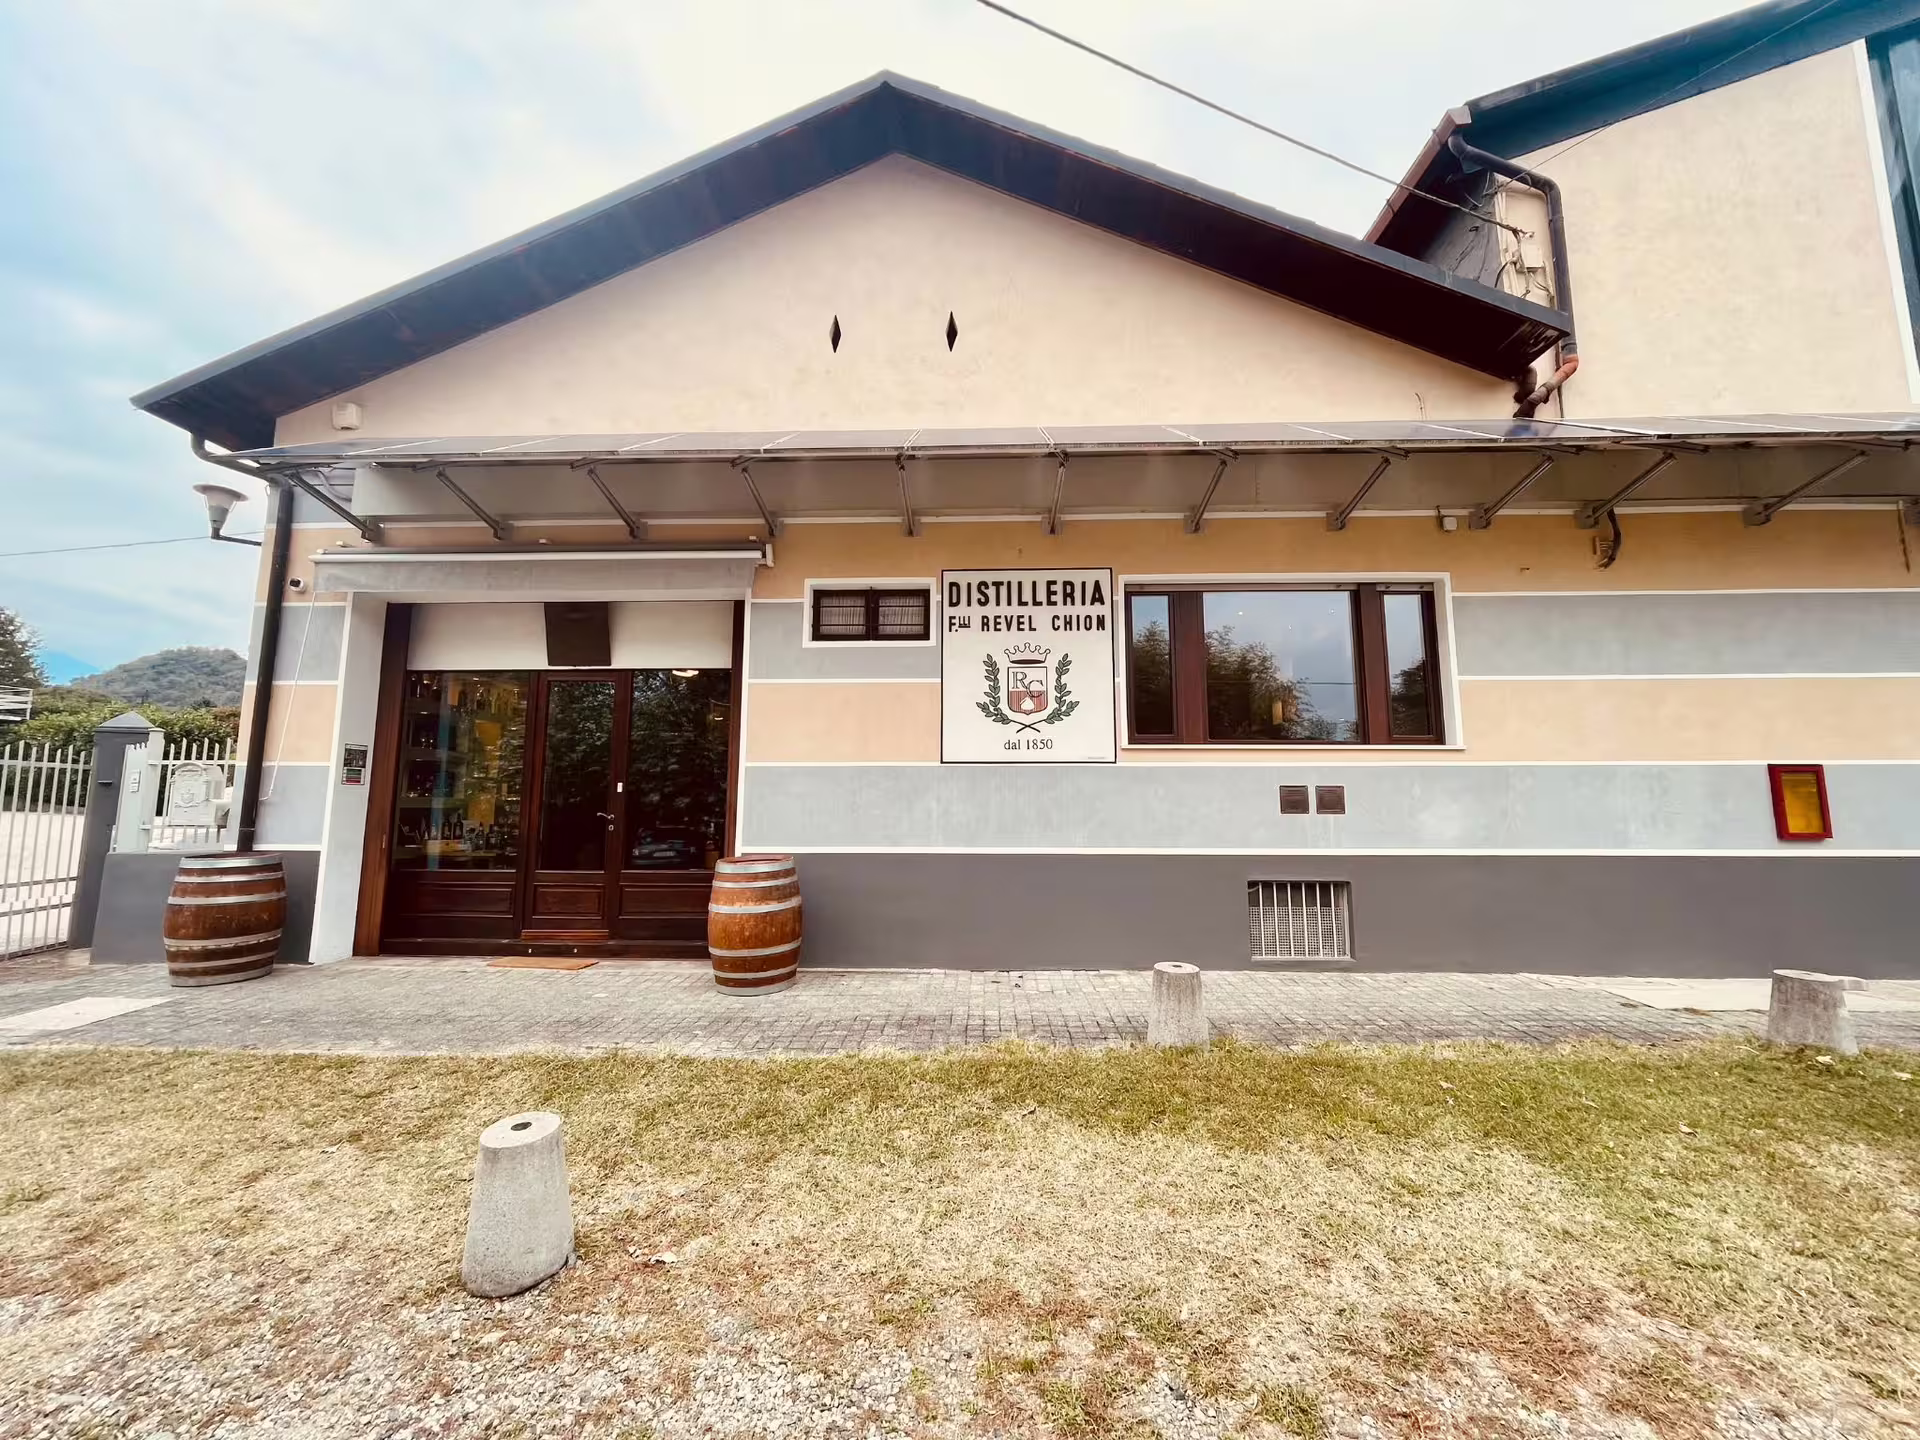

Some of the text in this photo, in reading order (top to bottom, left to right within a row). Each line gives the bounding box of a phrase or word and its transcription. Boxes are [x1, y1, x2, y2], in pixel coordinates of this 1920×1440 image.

[948, 579, 1106, 608] DISTILLERIA
[981, 614, 1037, 632] REVEL
[1051, 614, 1106, 632] CHION
[1003, 738, 1053, 751] dal 1850
